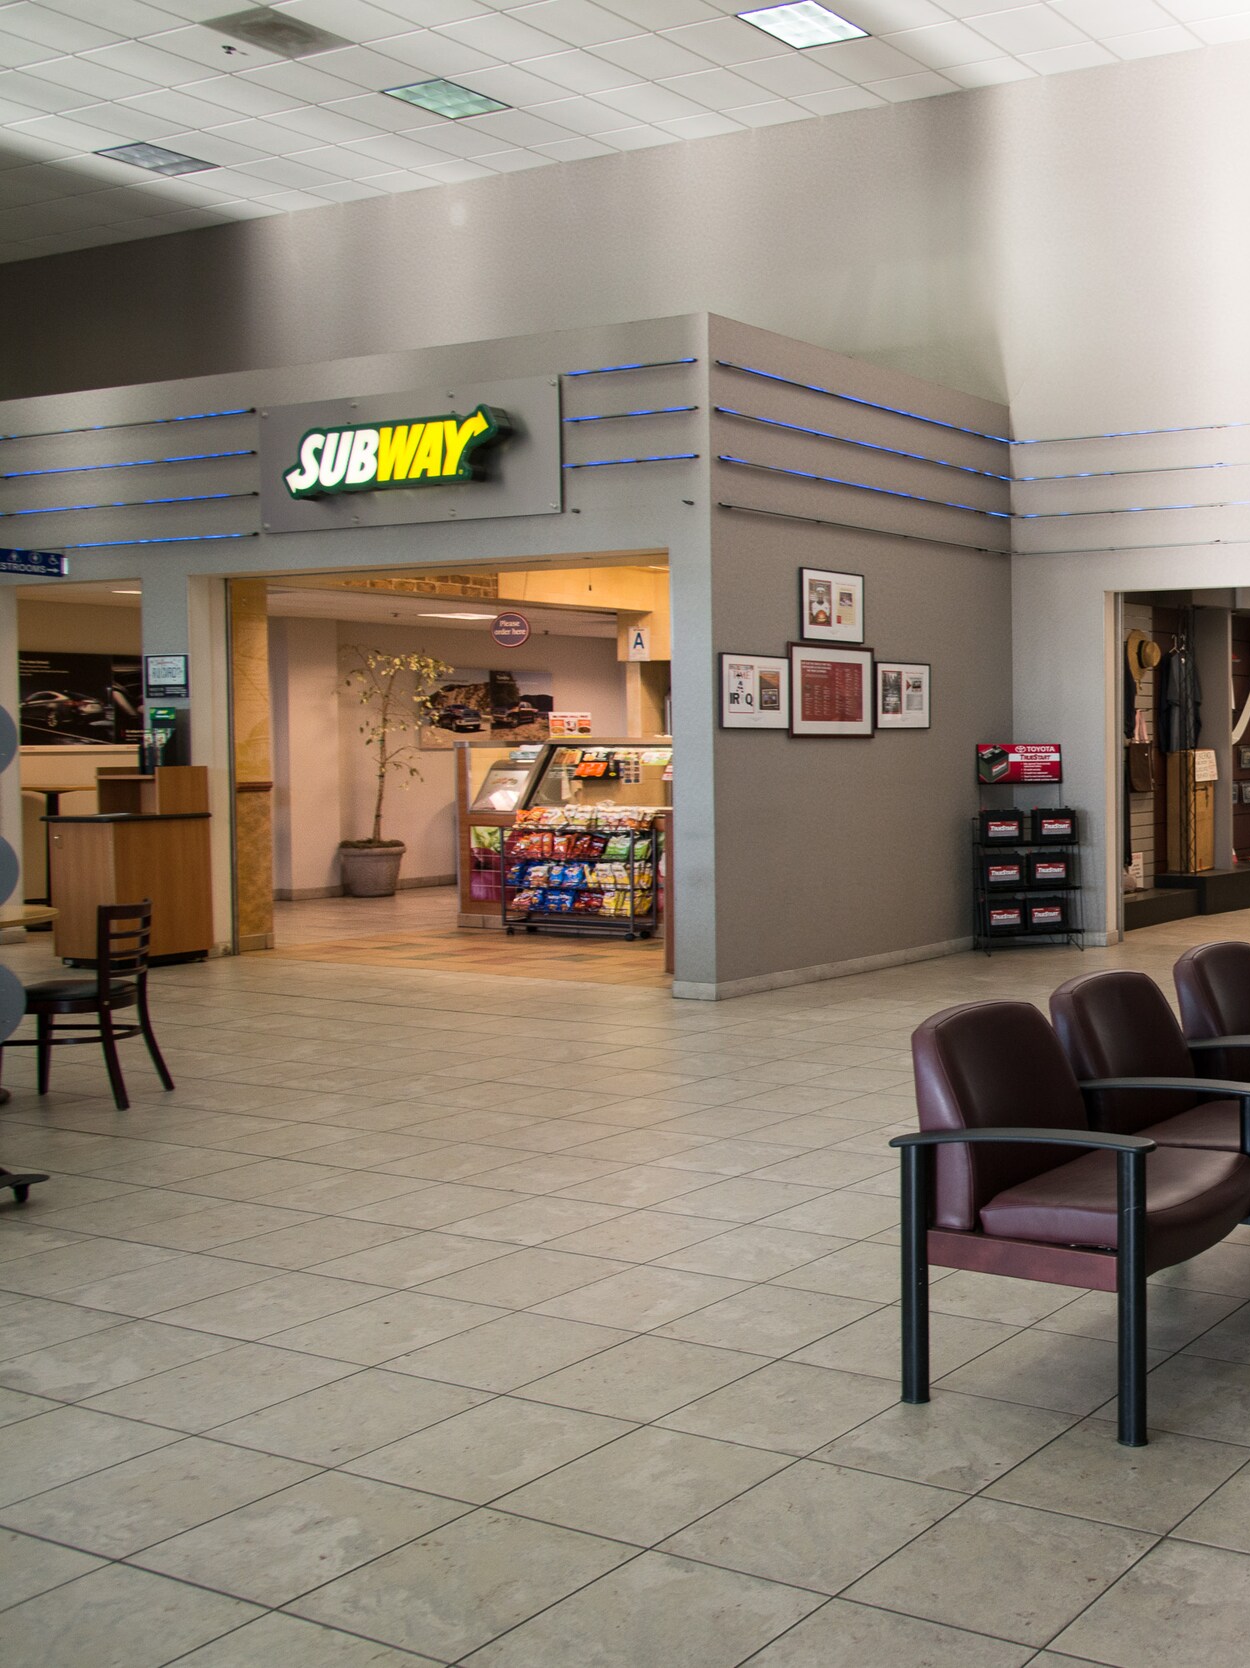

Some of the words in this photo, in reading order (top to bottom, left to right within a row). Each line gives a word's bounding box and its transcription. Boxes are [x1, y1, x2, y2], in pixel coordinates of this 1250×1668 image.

[285, 411, 489, 494] SUBWAY
[0, 562, 46, 573] STROOMS
[633, 632, 645, 649] A
[730, 693, 753, 706] IRQ
